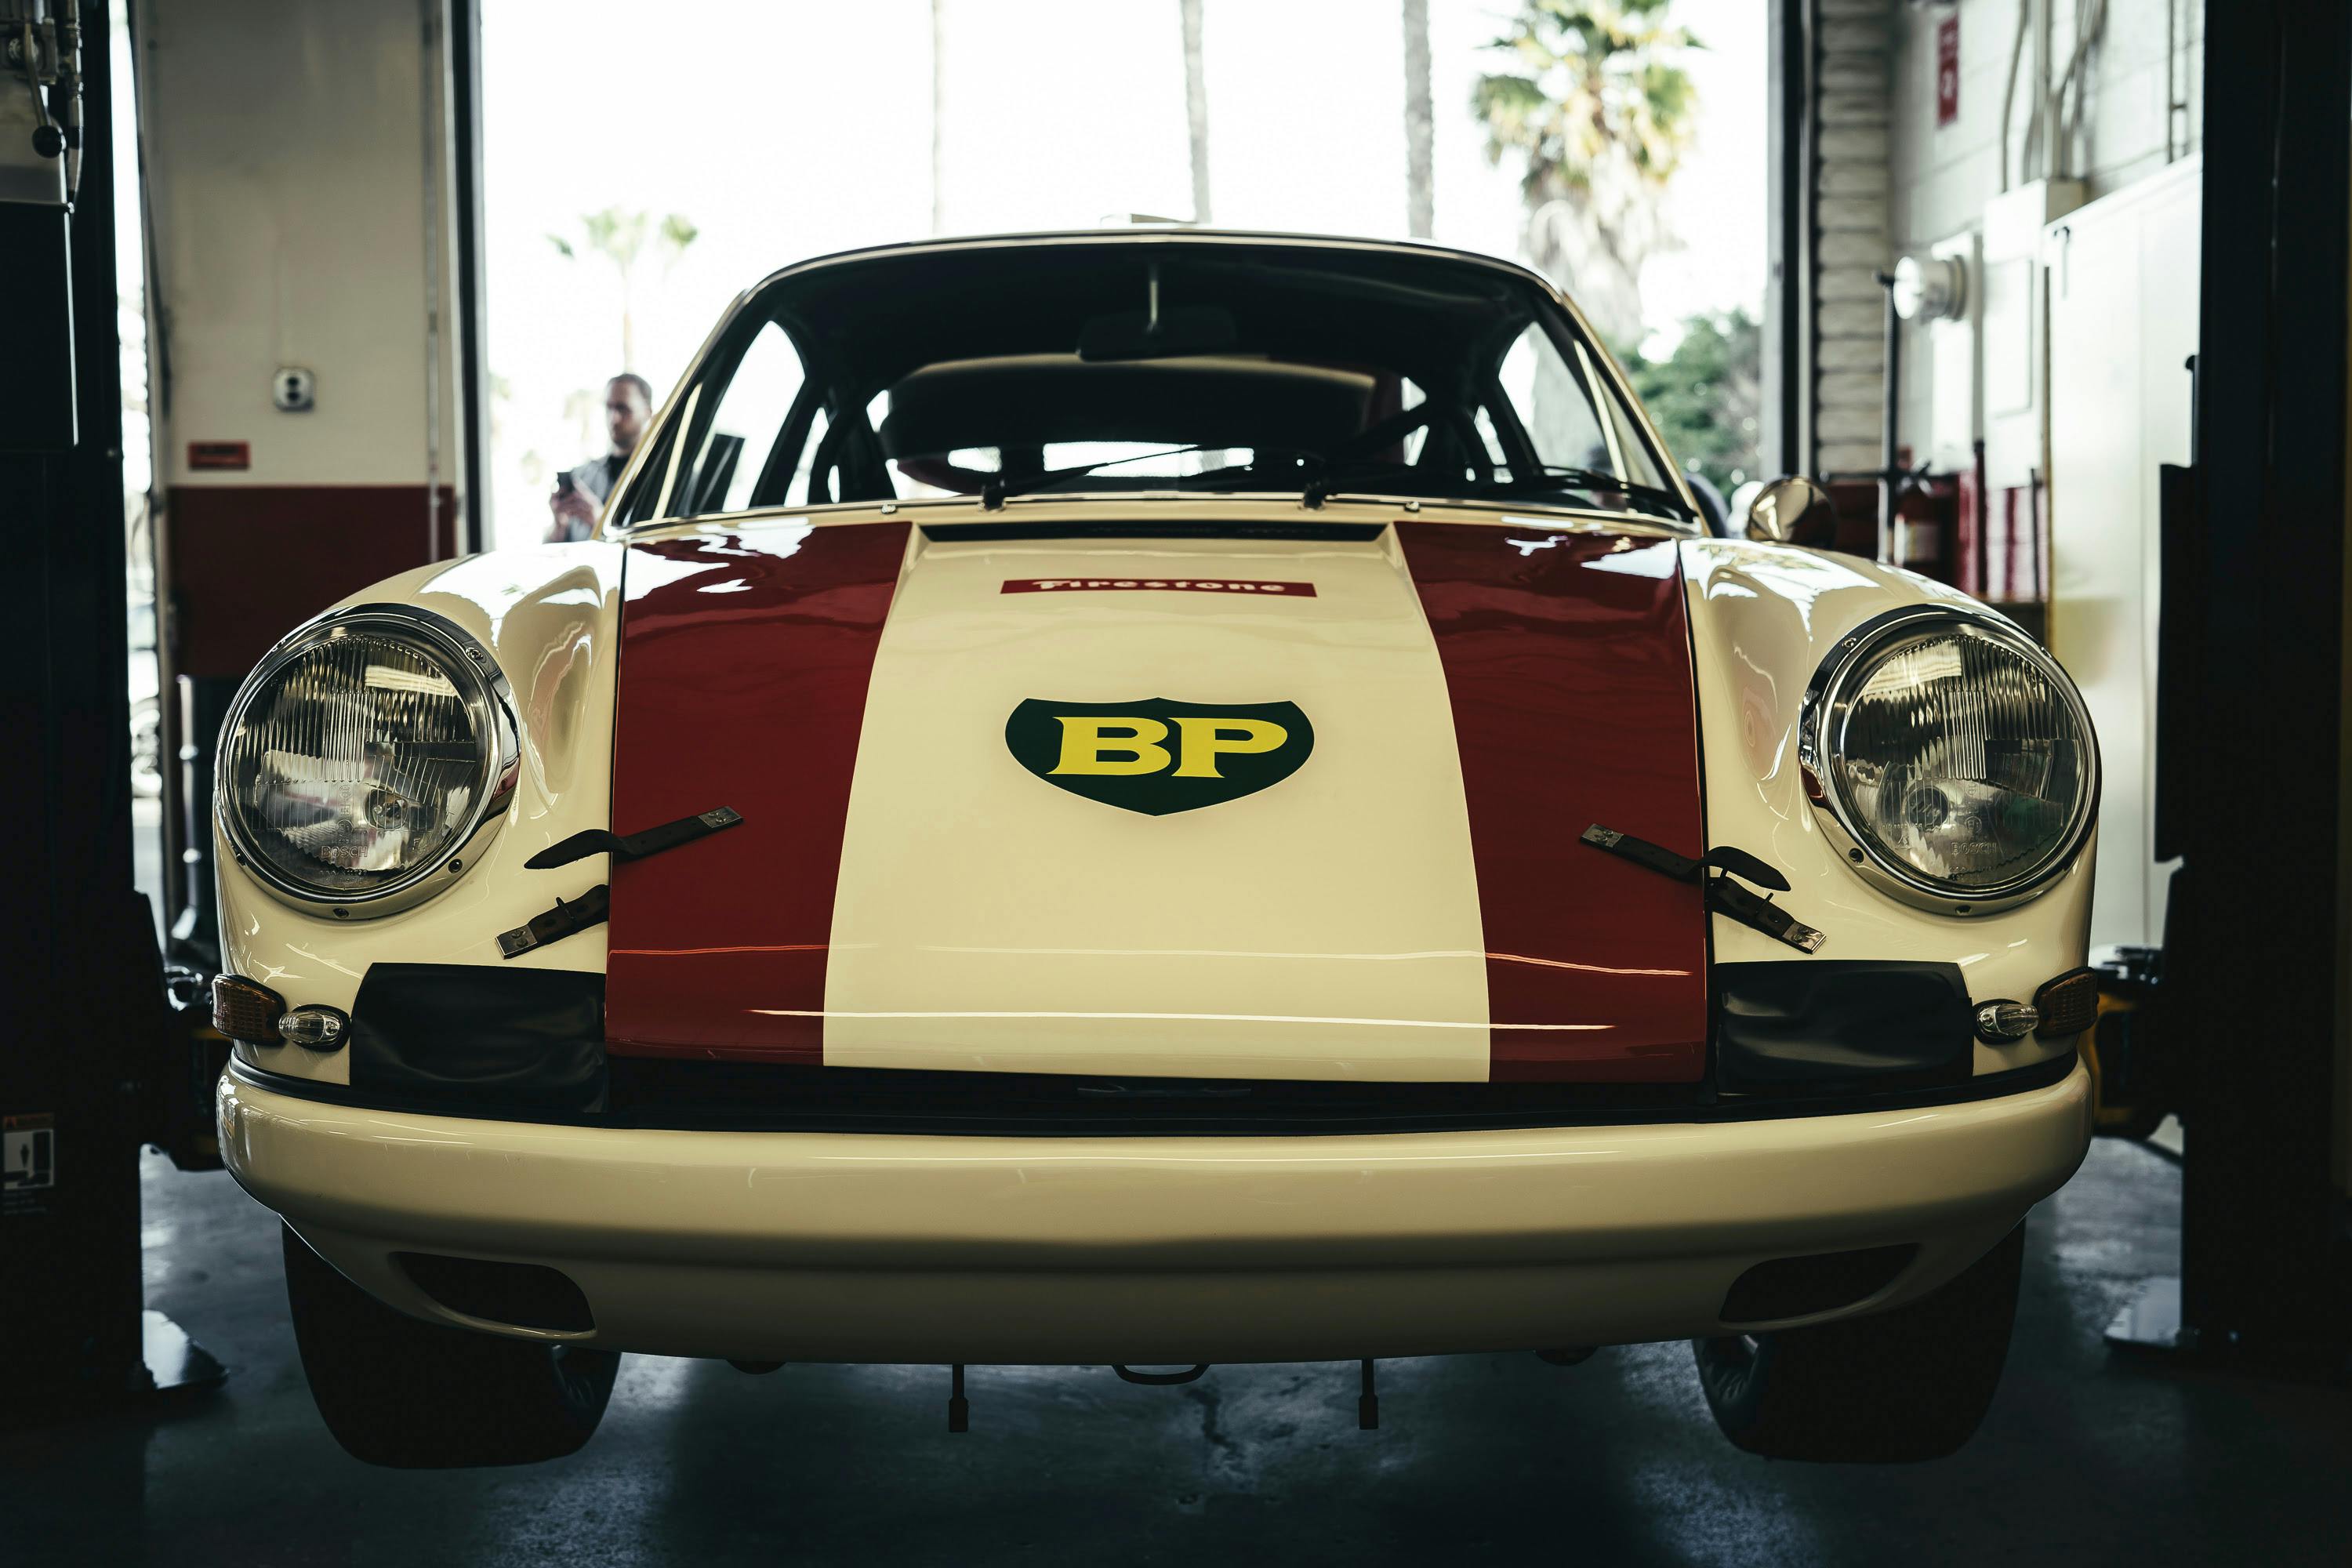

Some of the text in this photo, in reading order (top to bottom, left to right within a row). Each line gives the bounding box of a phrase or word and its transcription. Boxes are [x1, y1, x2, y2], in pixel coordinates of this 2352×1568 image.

[1032, 579, 1285, 592] Firestone
[1045, 717, 1288, 779] BP
[321, 845, 368, 858] BOSCH
[1951, 841, 1997, 855] BOSCH
